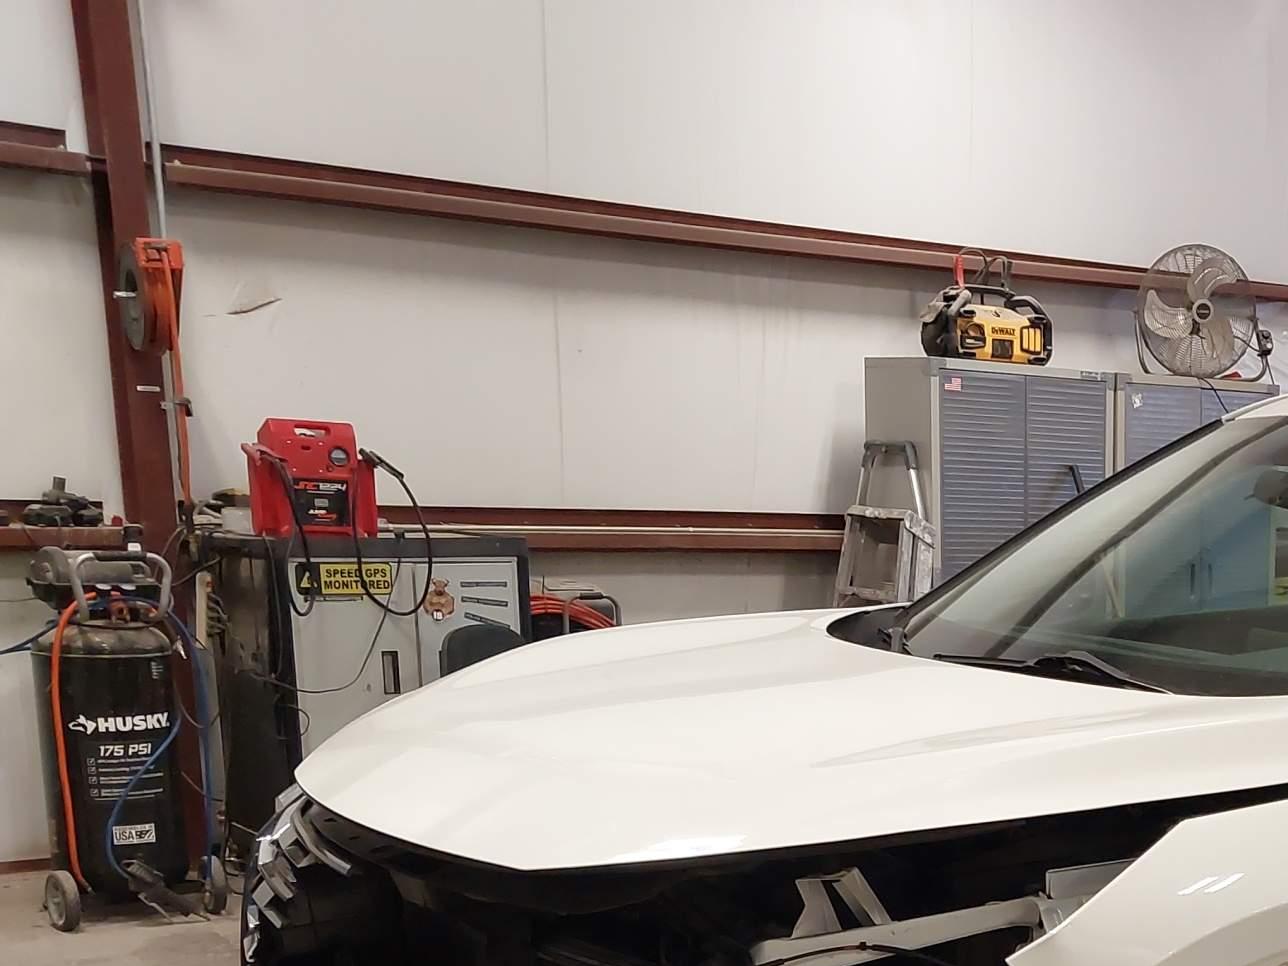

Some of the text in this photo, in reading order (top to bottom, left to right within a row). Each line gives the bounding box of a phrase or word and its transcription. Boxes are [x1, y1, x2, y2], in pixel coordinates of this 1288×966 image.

[325, 568, 387, 579] SPEED GPS
[97, 712, 169, 732] HUSKY
[99, 743, 152, 757] 175 PSI
[115, 831, 134, 841] USA
